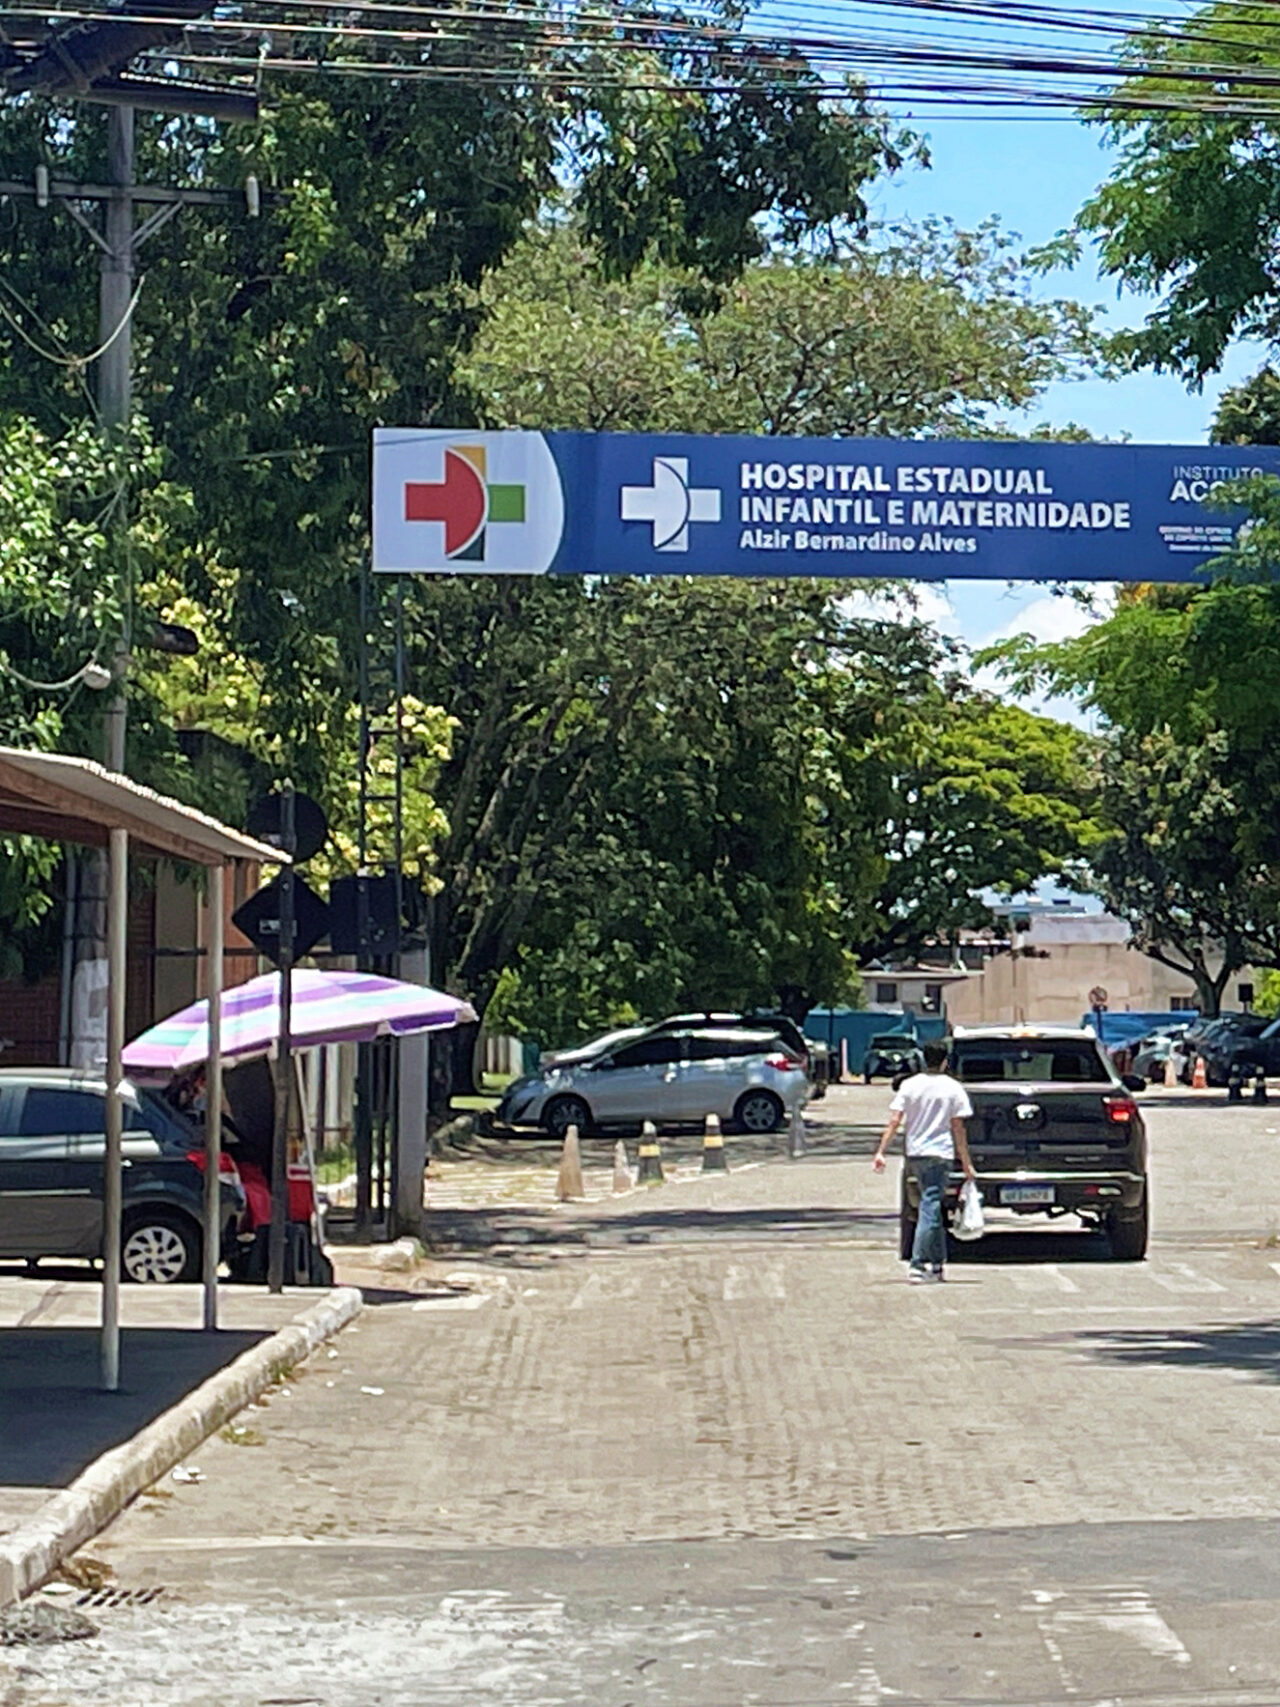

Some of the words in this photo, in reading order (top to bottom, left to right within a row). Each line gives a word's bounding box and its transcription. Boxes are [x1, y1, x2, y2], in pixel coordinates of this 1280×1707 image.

[741, 462, 891, 492] HOSPITAL
[897, 466, 1053, 495] ESTADUAL
[1173, 465, 1263, 481] INSTITUTO
[741, 496, 881, 524] INFANTIL
[887, 499, 905, 525] E
[911, 500, 1131, 529] MATERNIDADE
[740, 528, 791, 549] Alzir
[794, 530, 916, 552] Bernardino
[918, 531, 977, 553] Alves
